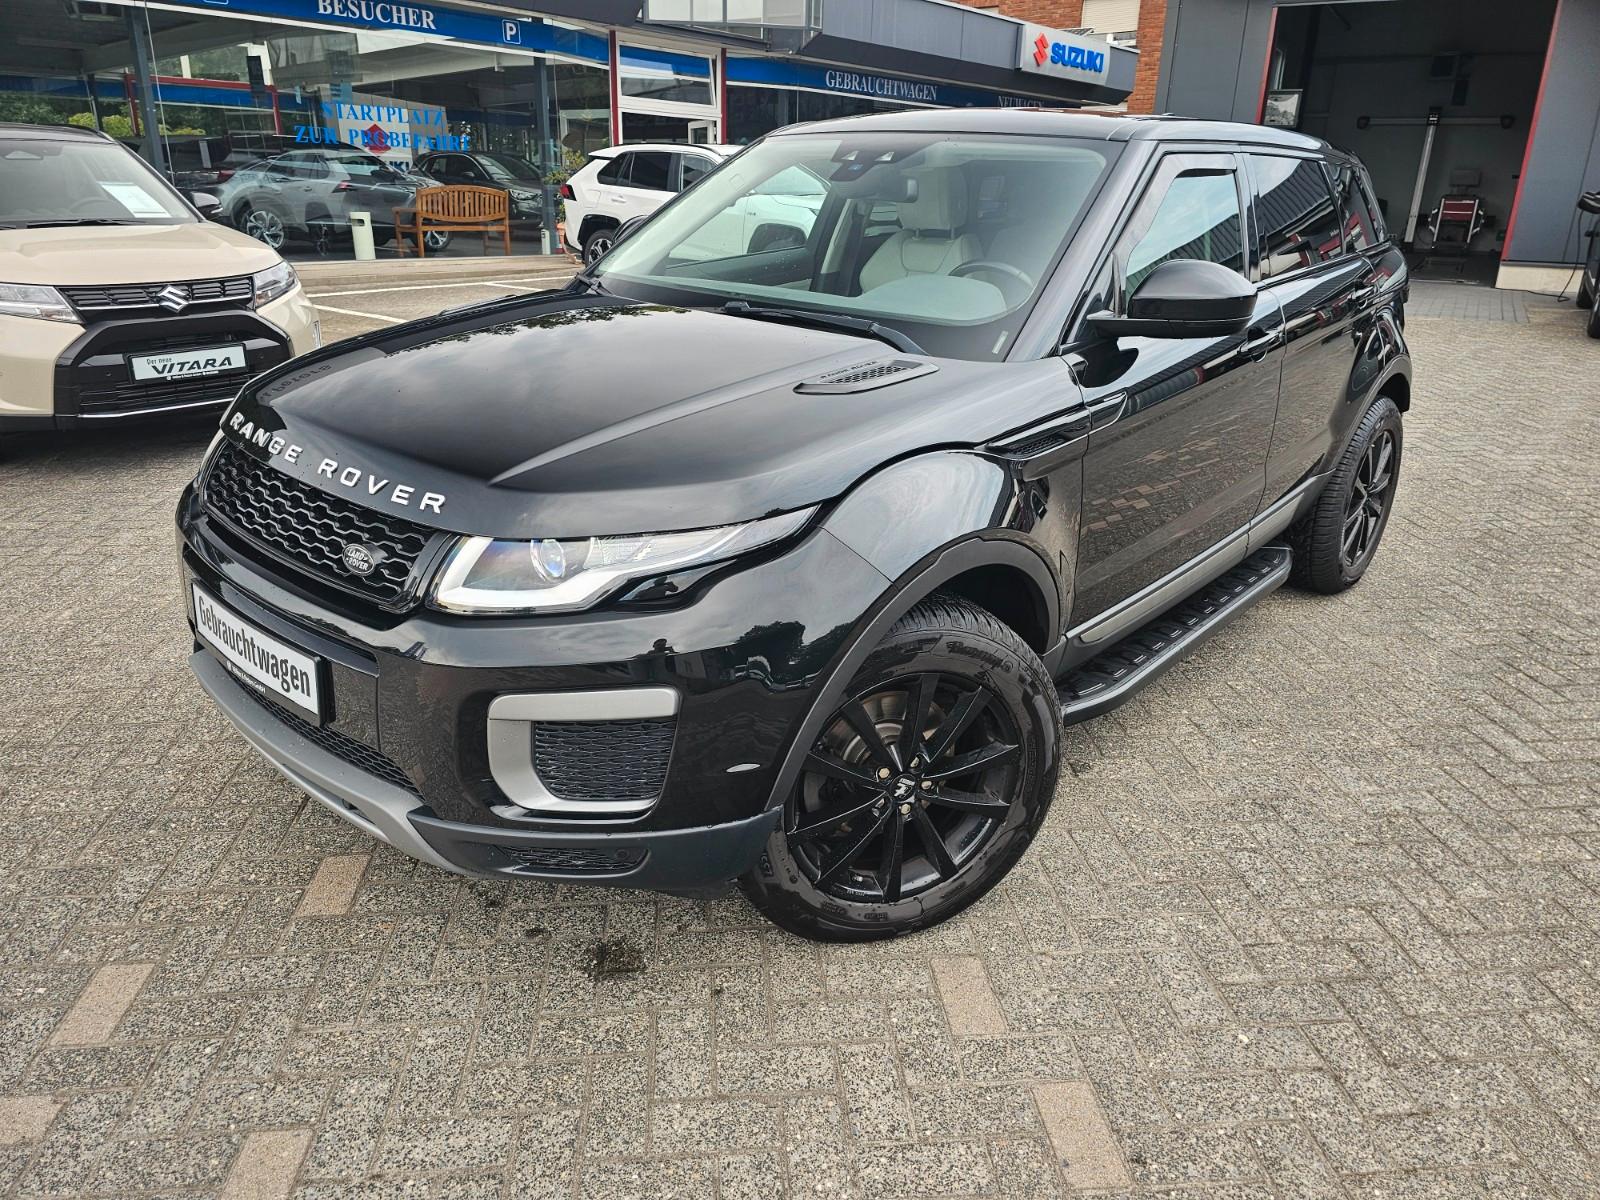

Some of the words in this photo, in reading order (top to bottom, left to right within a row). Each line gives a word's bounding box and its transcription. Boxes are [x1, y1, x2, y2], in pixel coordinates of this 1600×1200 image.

[317, 0, 436, 30] BESUCHER
[505, 22, 517, 41] P
[1050, 42, 1104, 73] SUZUKI
[825, 70, 938, 101] GEBRAUCHTWAGEN
[320, 101, 444, 126] STARTPLATZ
[294, 125, 339, 145] ZUR
[349, 128, 471, 152] PROBEFAHRT
[151, 356, 232, 375] VITARA
[229, 411, 303, 464] RANGE
[317, 458, 446, 514] ROVER
[198, 595, 312, 698] Gebrauchtwagen
